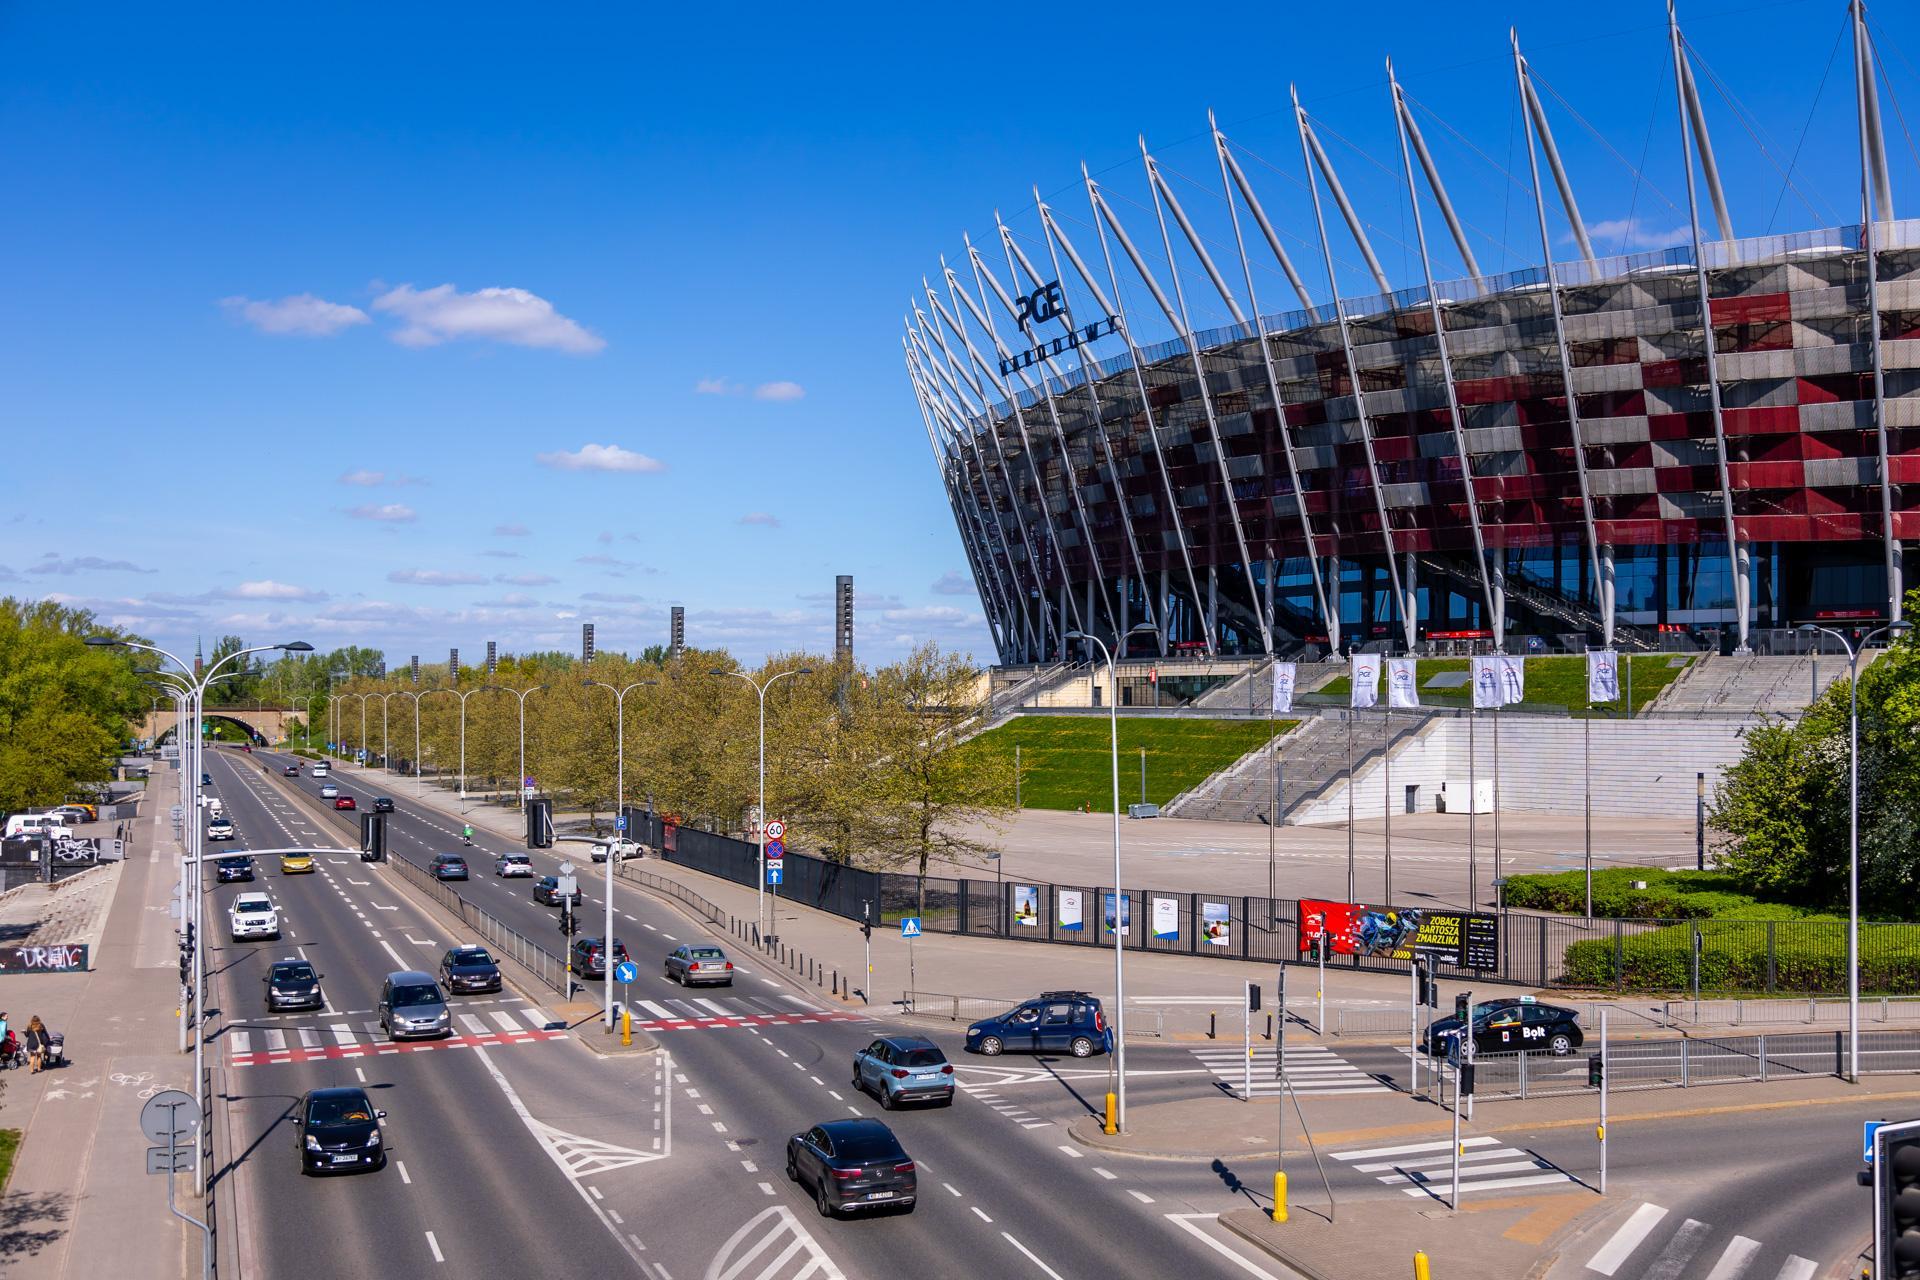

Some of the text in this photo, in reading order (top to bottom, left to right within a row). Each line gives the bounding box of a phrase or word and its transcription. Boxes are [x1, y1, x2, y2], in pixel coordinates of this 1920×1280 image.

[1016, 280, 1066, 332] PGE
[999, 315, 1120, 377] NARODOWY
[618, 818, 625, 829] P
[769, 825, 782, 835] 60
[1430, 916, 1461, 927] ZOBACZ
[1419, 925, 1460, 936] BARTOSZA
[1415, 934, 1460, 946] ZMARZLIKA
[1522, 1026, 1546, 1040] Bolt
